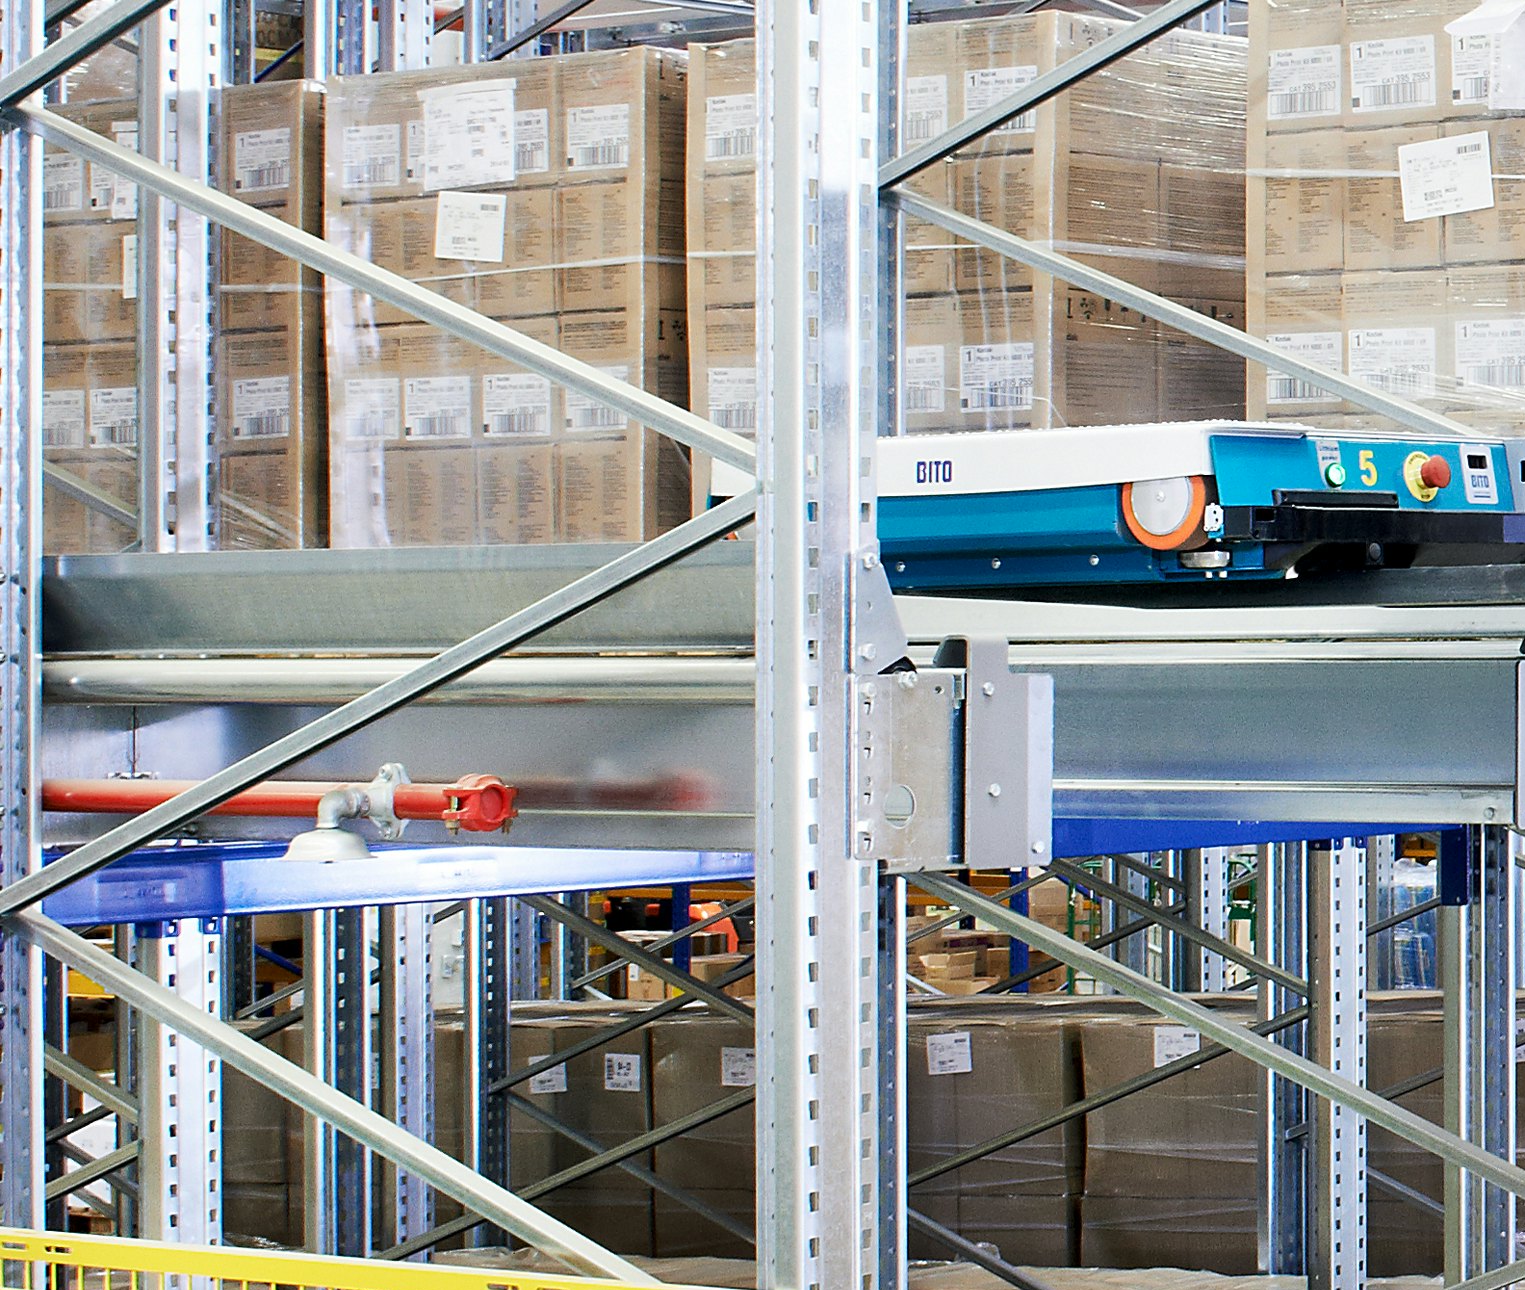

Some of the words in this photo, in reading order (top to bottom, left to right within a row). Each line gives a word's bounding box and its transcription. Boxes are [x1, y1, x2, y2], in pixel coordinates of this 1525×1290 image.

[1459, 38, 1464, 50] 1
[1357, 47, 1362, 58] 1
[970, 75, 976, 86] 1
[1462, 326, 1467, 338] 1
[1356, 335, 1360, 346] 1
[966, 351, 971, 362] 1
[917, 461, 952, 483] BITO
[1359, 450, 1378, 486] 5
[1471, 474, 1490, 488] BITO
